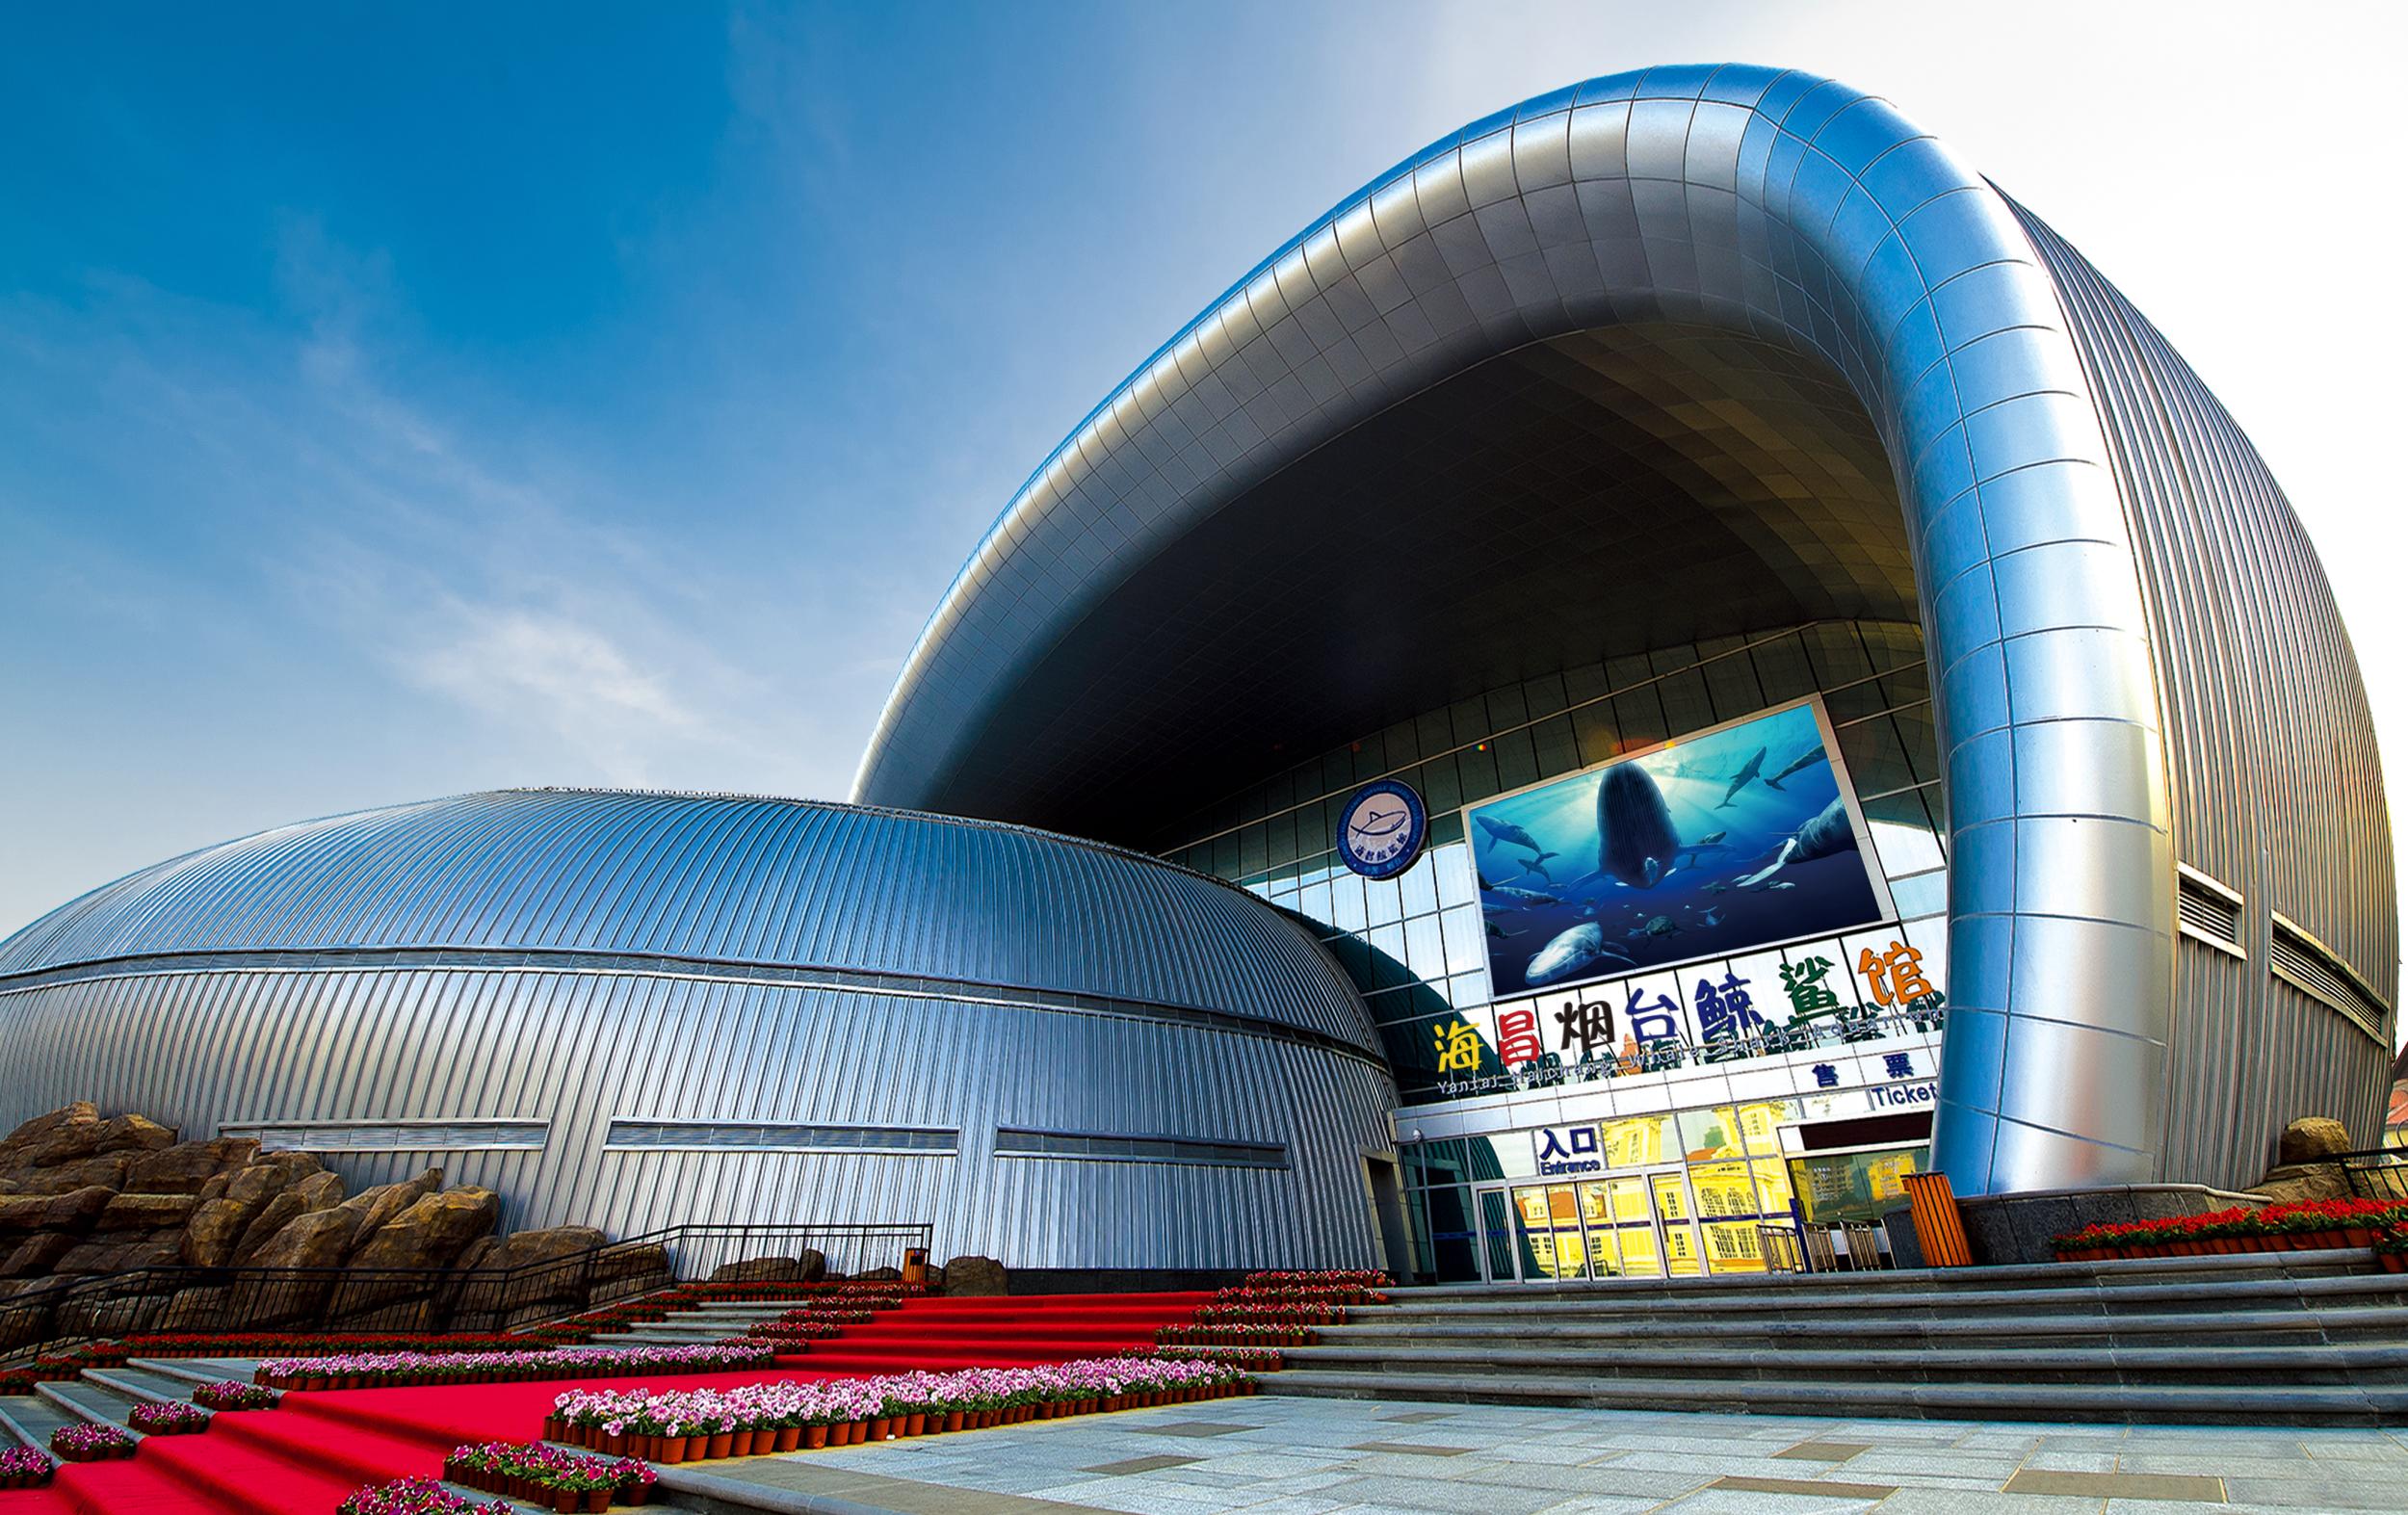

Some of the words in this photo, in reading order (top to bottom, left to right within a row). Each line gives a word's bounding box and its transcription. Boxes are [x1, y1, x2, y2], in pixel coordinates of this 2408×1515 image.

[1433, 940, 1935, 1073] 海昌烟台鲸鲨馆
[1437, 1074, 1498, 1095] Yantai
[1539, 1127, 1599, 1162] 入口
[1540, 1159, 1601, 1176] Entrance
